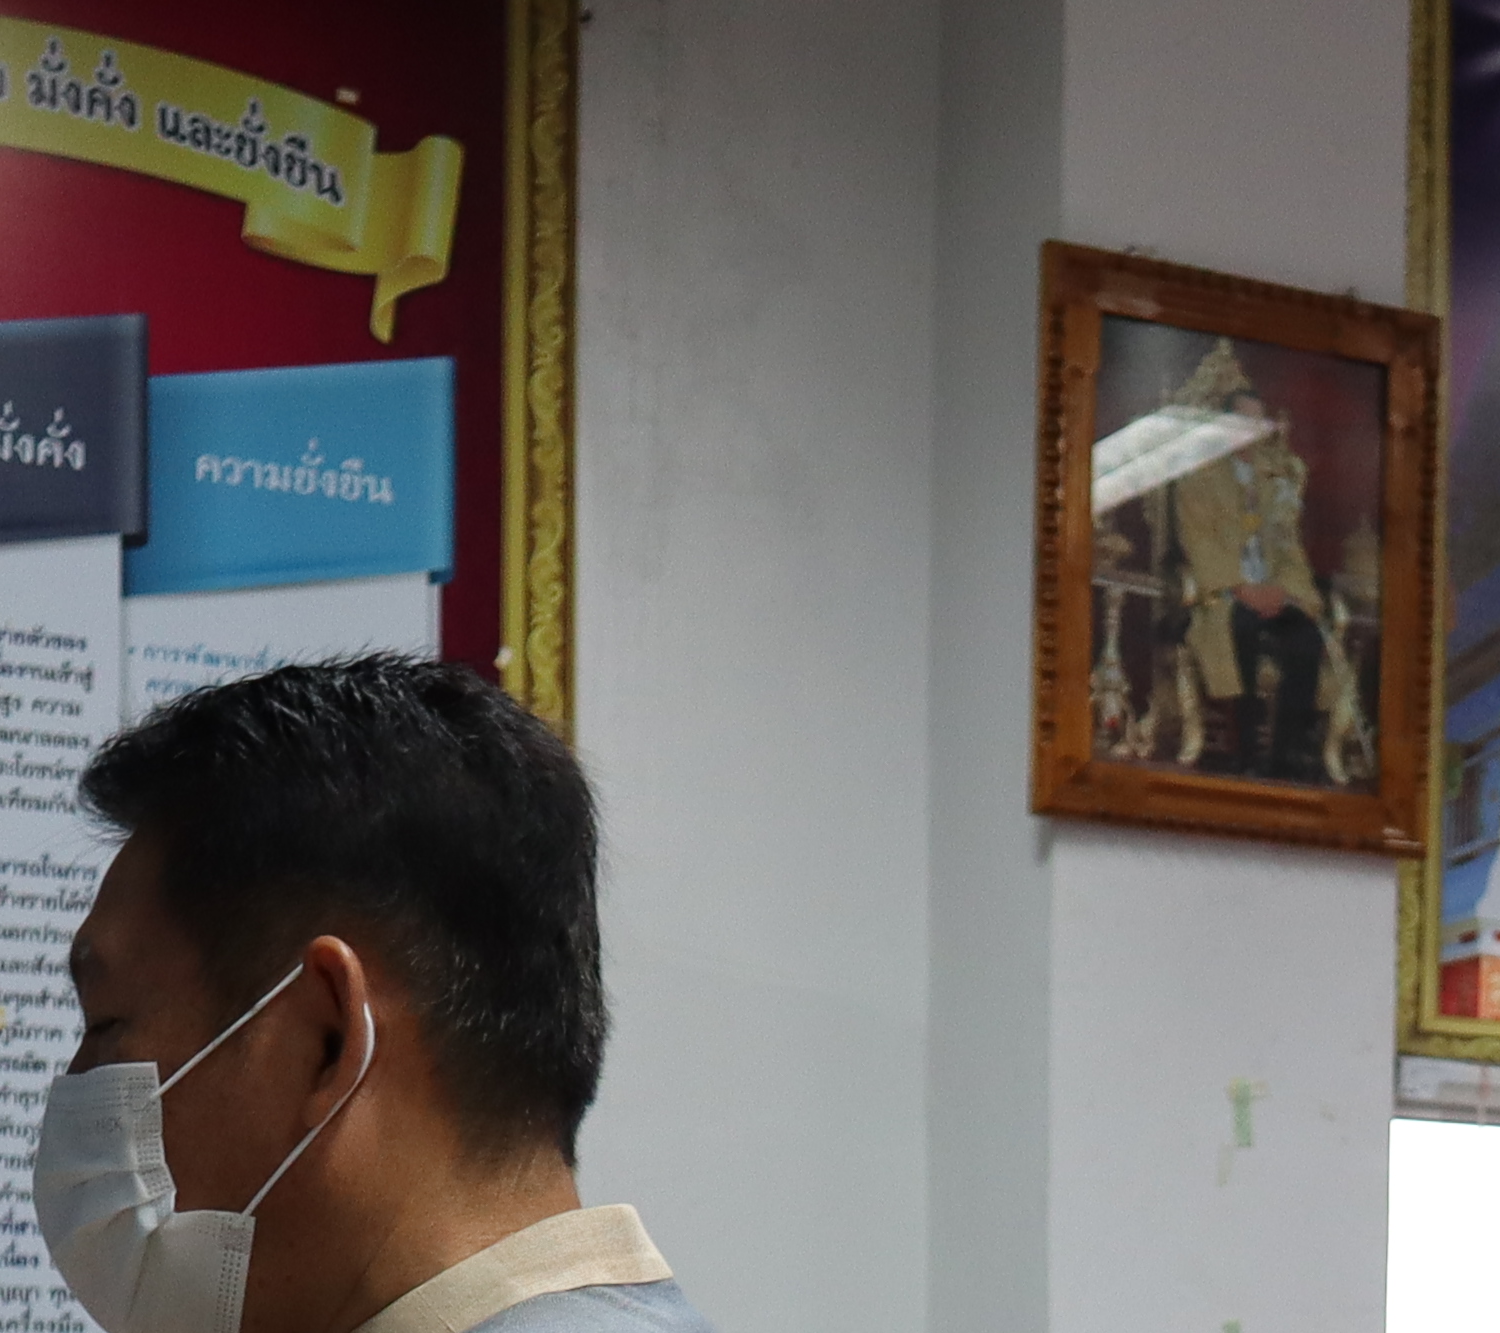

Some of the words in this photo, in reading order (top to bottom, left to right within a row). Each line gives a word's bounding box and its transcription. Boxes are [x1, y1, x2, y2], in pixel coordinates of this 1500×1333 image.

[26, 34, 142, 131] มั่งคั่ง
[156, 96, 345, 206] และยั่งยืน
[194, 437, 394, 505] ความยั่งยืน
